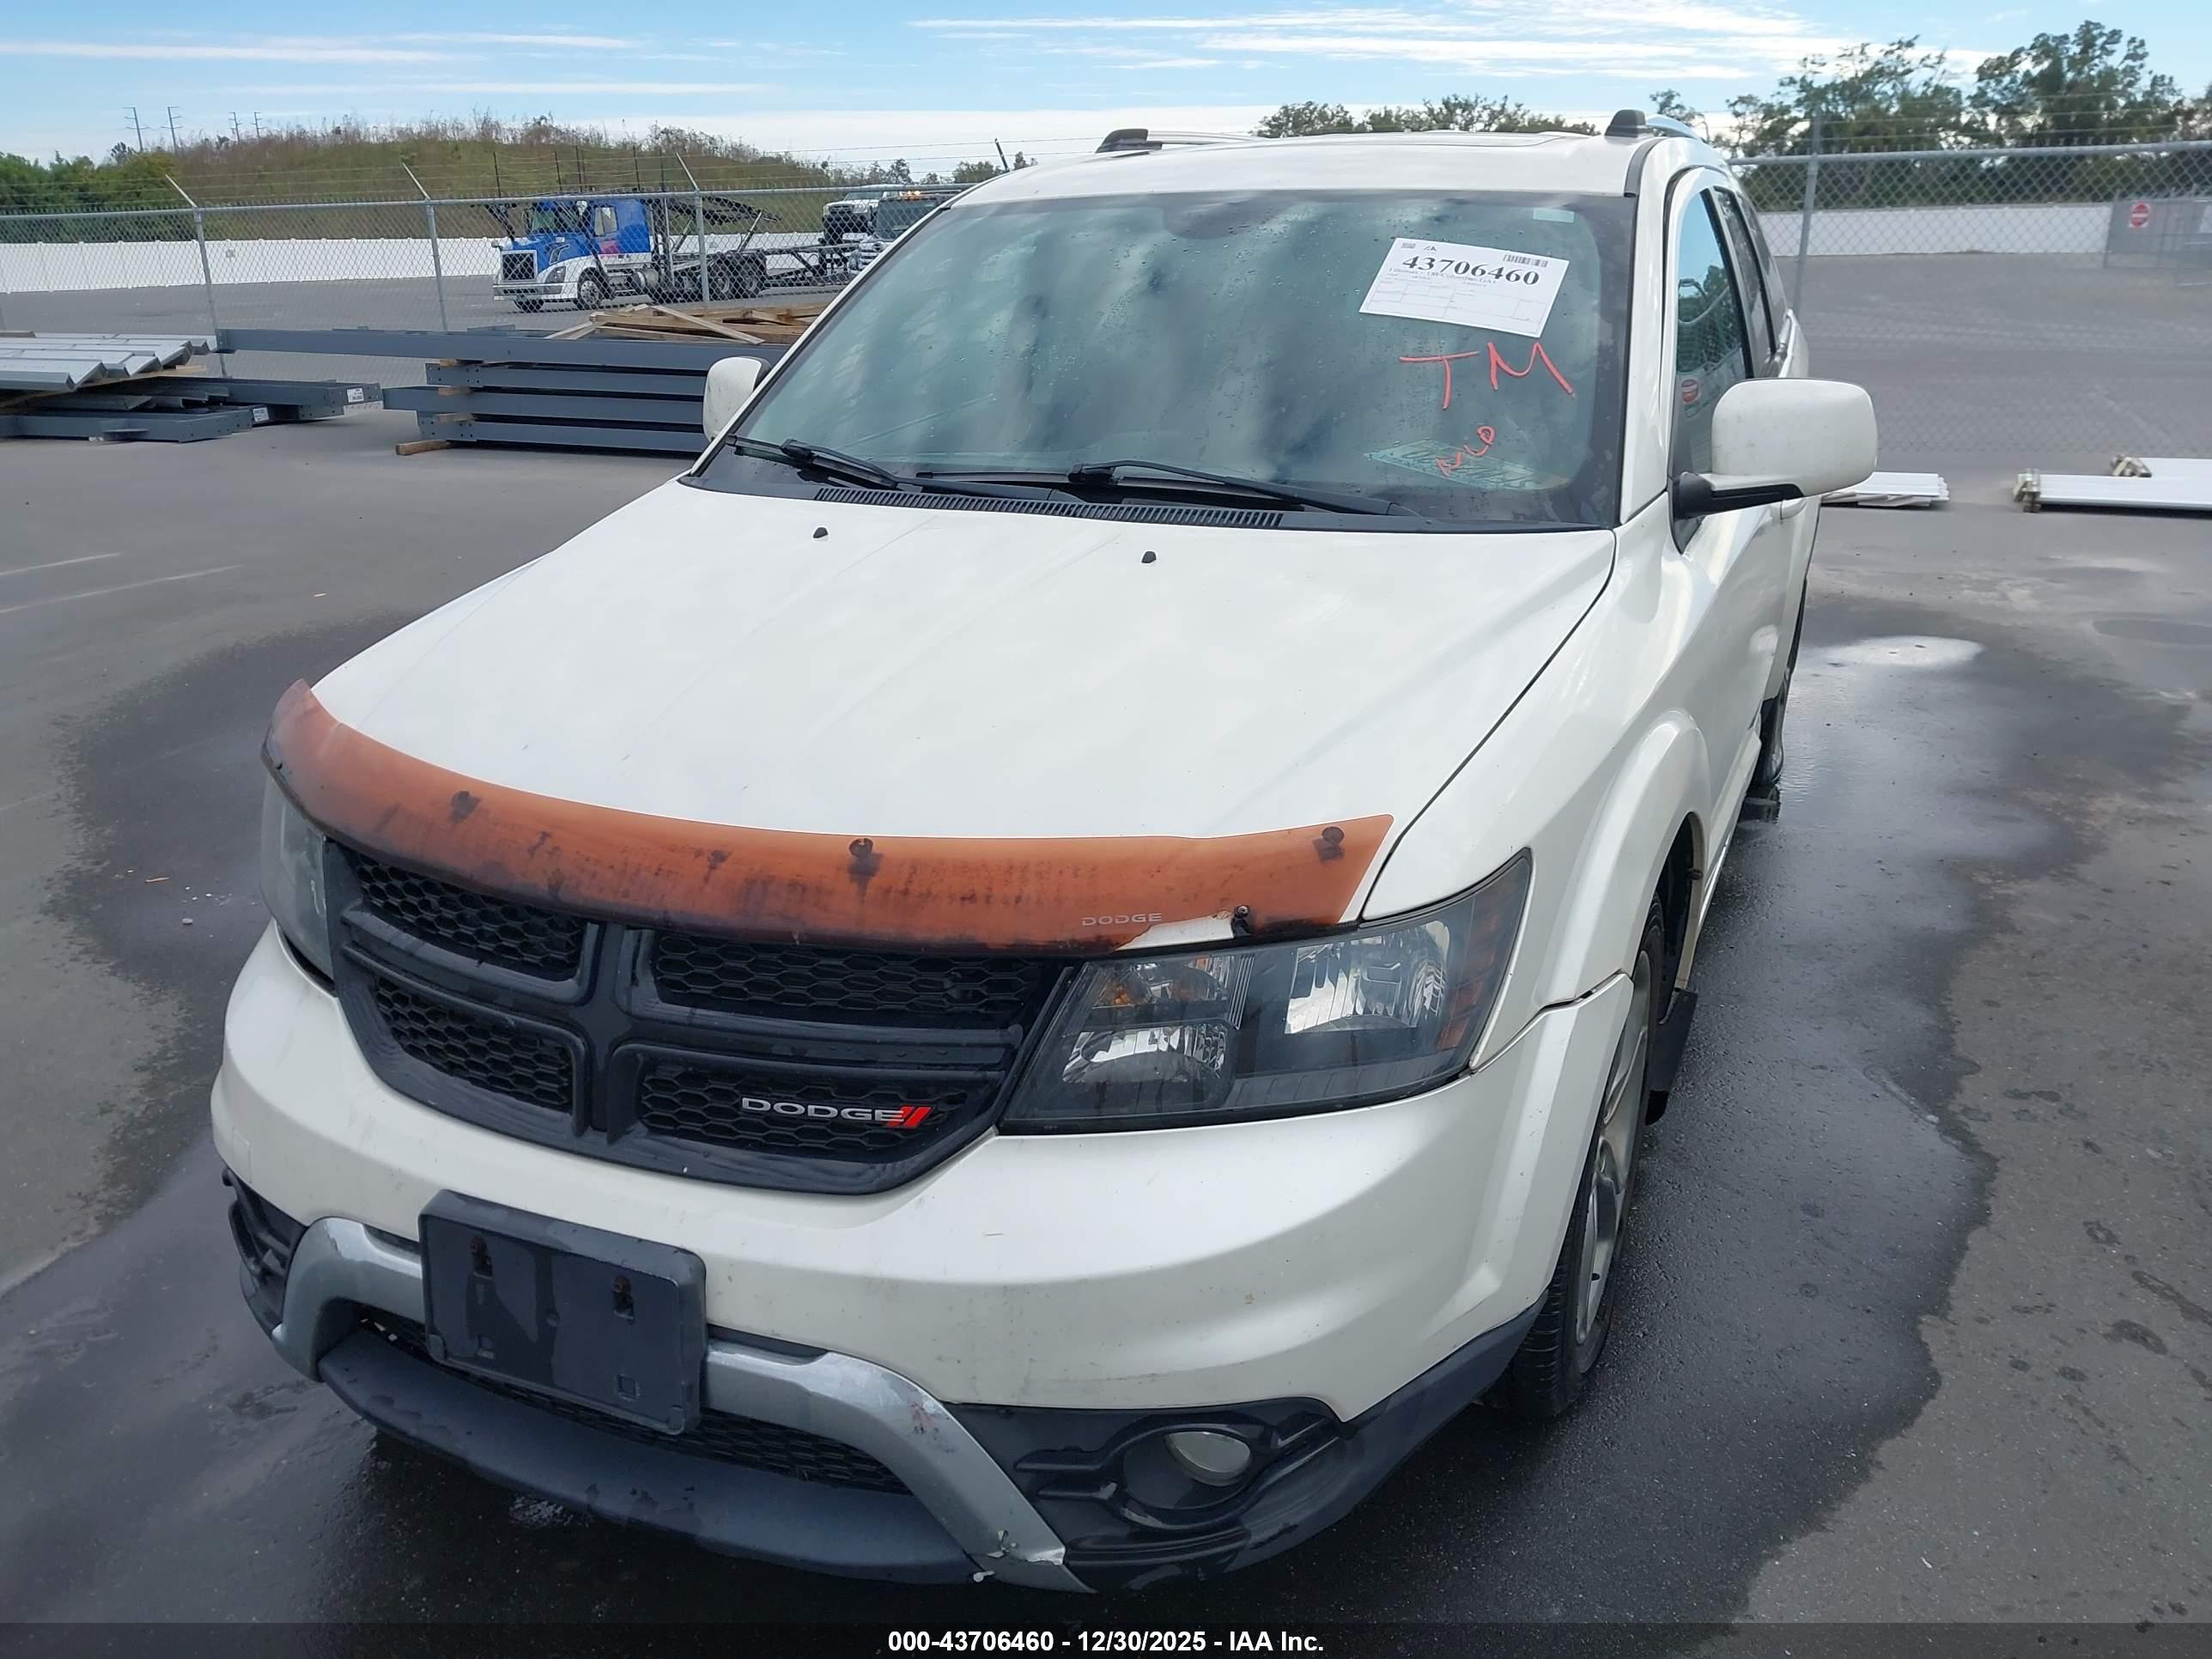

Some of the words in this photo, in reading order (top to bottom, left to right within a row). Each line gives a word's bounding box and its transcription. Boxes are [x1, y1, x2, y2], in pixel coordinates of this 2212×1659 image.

[1401, 254, 1540, 285] 43706460
[1081, 913, 1162, 926] DODGE
[741, 1097, 904, 1122] DODGE
